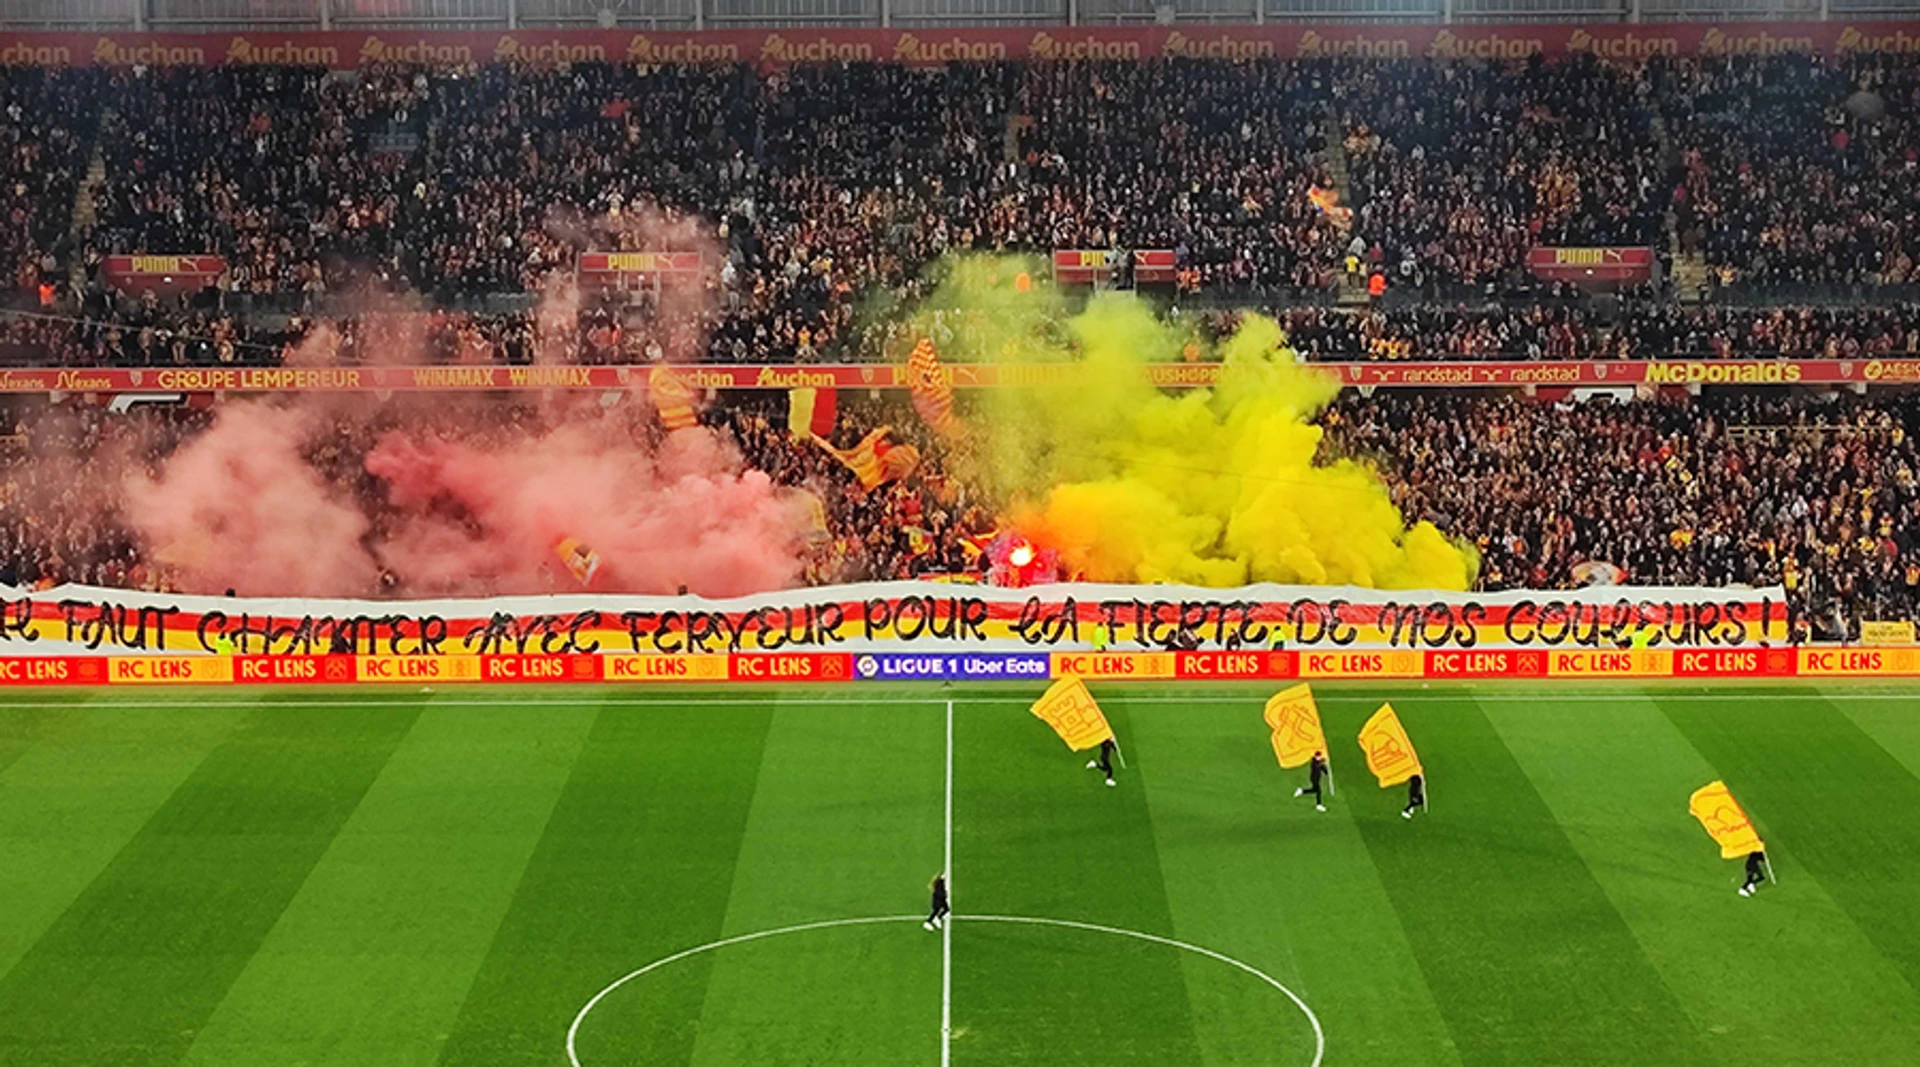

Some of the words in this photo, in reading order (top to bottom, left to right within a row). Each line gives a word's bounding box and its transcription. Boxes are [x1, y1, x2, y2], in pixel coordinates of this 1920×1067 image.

[92, 37, 205, 65] Auchan
[225, 36, 338, 65] Auchan
[359, 35, 471, 63] Auchan
[626, 33, 739, 61] Auchan
[760, 33, 872, 61] Auchan
[892, 32, 1005, 61] Auchan
[1027, 31, 1140, 60] Auchan
[1162, 30, 1274, 59] Auchan
[1296, 29, 1410, 58] Auchan
[132, 257, 179, 272] PUMA
[608, 254, 655, 270] PUMA
[1556, 250, 1603, 264] PUMA
[55, 370, 111, 389] Nexans
[157, 371, 235, 388] GROUPE
[240, 370, 360, 388] LEMPEREUR
[413, 368, 494, 386] WINAMAX
[510, 368, 591, 386] WINAMAX
[756, 367, 836, 387] Auchan
[1402, 366, 1474, 383] randstad
[1510, 365, 1580, 382] randstad
[1645, 362, 1802, 383] McDonald's
[58, 599, 180, 651] FAUT
[196, 610, 446, 654] CHANTER
[463, 611, 600, 654] AVEC
[864, 595, 988, 643] POUR
[1286, 598, 1358, 645] DE
[1378, 600, 1485, 648] NOS
[26, 661, 68, 679] LENS
[118, 660, 144, 679] RC
[151, 660, 192, 679] LENS
[242, 659, 269, 678] RC
[275, 659, 316, 678] LENS
[366, 659, 393, 677] RC
[399, 659, 439, 677] LENS
[490, 659, 515, 677] RC
[522, 659, 563, 677] LENS
[614, 659, 639, 677] RC
[646, 659, 687, 677] LENS
[737, 658, 763, 676] RC
[770, 658, 811, 676] LENS
[883, 657, 944, 674] LIGUE
[948, 657, 958, 674] 1
[963, 657, 1003, 674] Uber
[1006, 657, 1046, 674] Eats
[1060, 657, 1087, 674] RC
[1092, 657, 1133, 674] LENS
[1184, 656, 1211, 674] RC
[1217, 656, 1258, 674] LENS
[1309, 655, 1335, 673] RC
[1341, 655, 1383, 673] LENS
[1433, 654, 1459, 672] RC
[1465, 654, 1507, 672] LENS
[1557, 654, 1584, 671] RC
[1590, 654, 1632, 671] LENS
[1682, 653, 1708, 671] RC
[1715, 653, 1757, 671] LENS
[1807, 653, 1834, 670] RC
[1840, 653, 1882, 670] LENS
